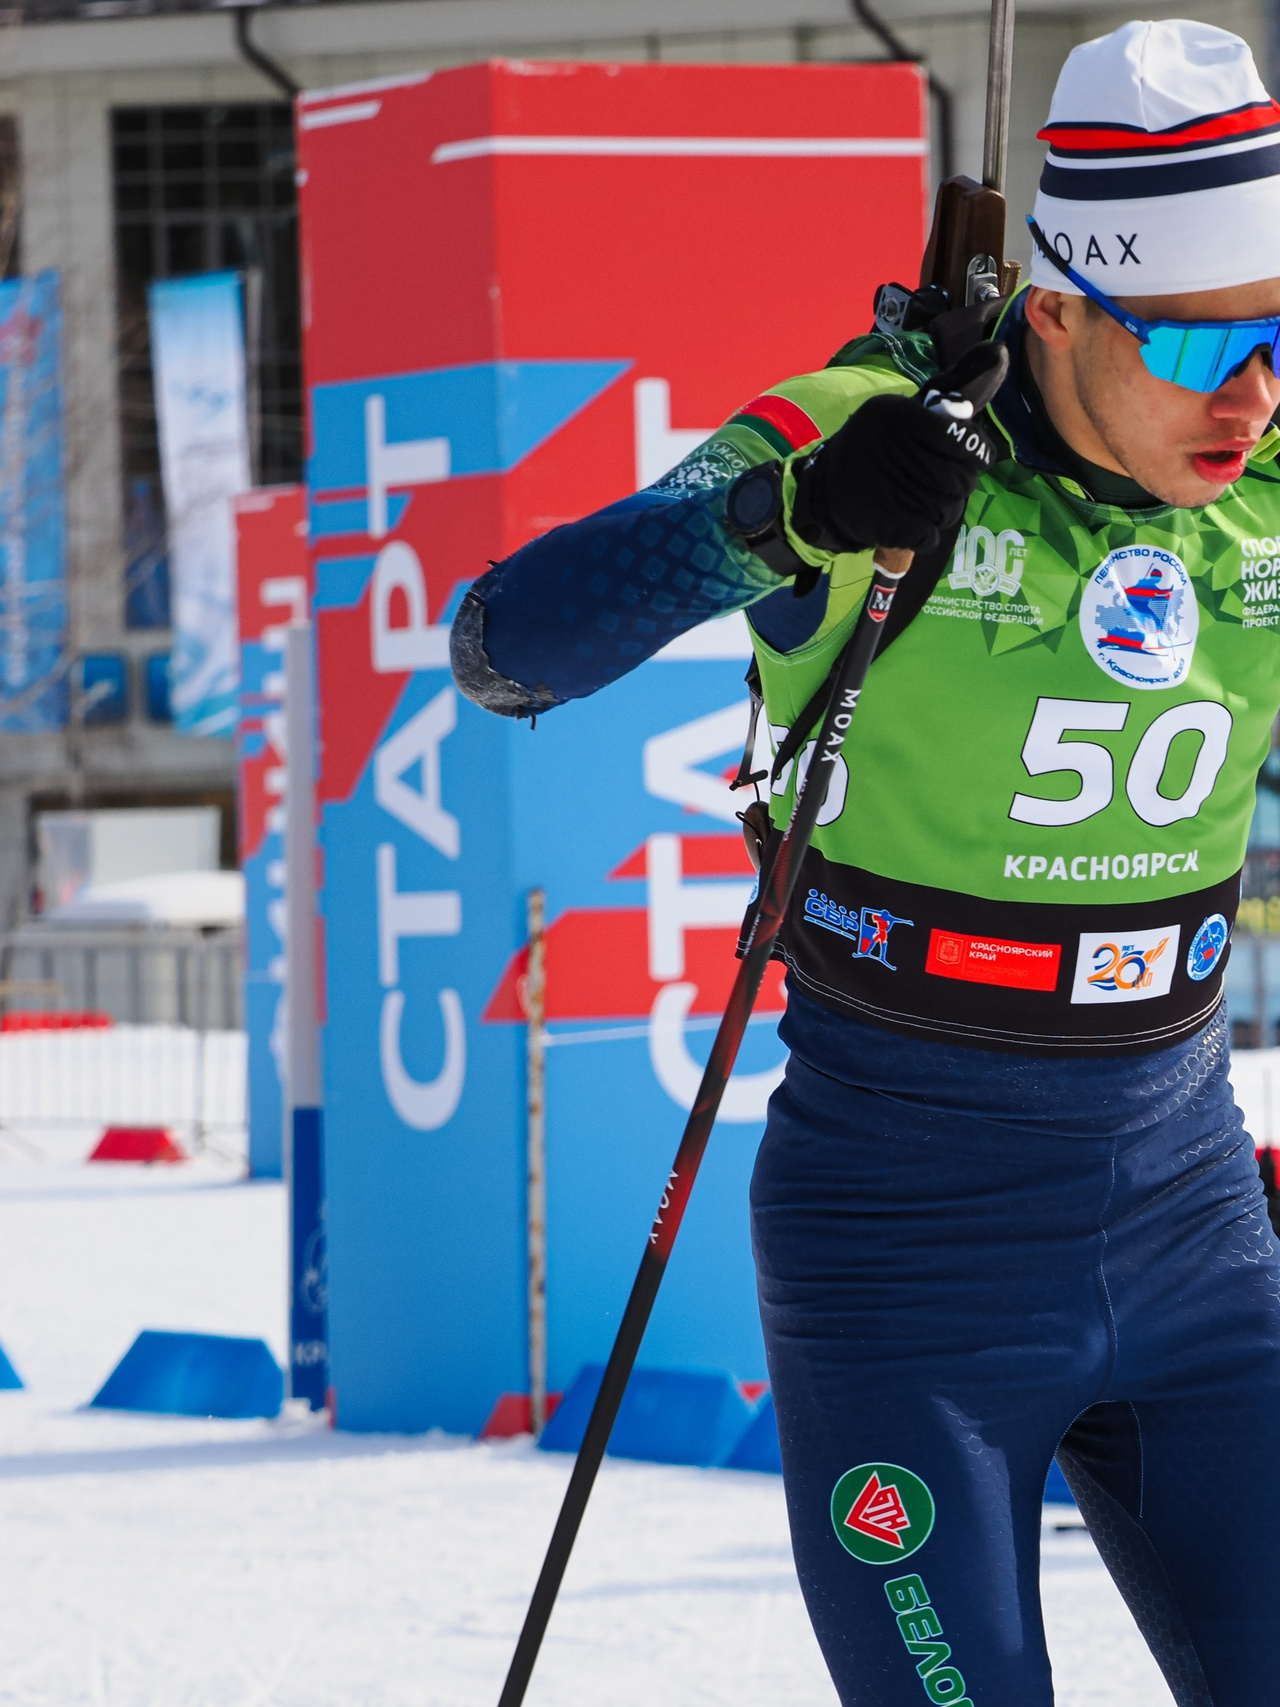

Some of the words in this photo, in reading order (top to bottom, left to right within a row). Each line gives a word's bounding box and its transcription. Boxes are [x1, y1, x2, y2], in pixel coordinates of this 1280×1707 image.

[1008, 547, 1029, 558] ЛЕТ
[1153, 550, 1188, 586] РОССИИ
[983, 613, 1044, 626] ФЕДЕРАЦИИ
[1005, 602, 1041, 615] СПОРТА
[1242, 615, 1280, 629] ПРОЕКТ
[821, 688, 861, 763] MOAX
[366, 395, 466, 1132] СТАРТ
[1007, 696, 1234, 827] 50
[1003, 849, 1200, 881] КРАСНОЯРСК
[804, 896, 860, 933] СБР
[968, 951, 997, 961] КРАЙ
[970, 941, 1053, 958] КРАСНОЯРСКИЙ
[1086, 942, 1146, 990] 20
[884, 1573, 975, 1707] БЕЛО
